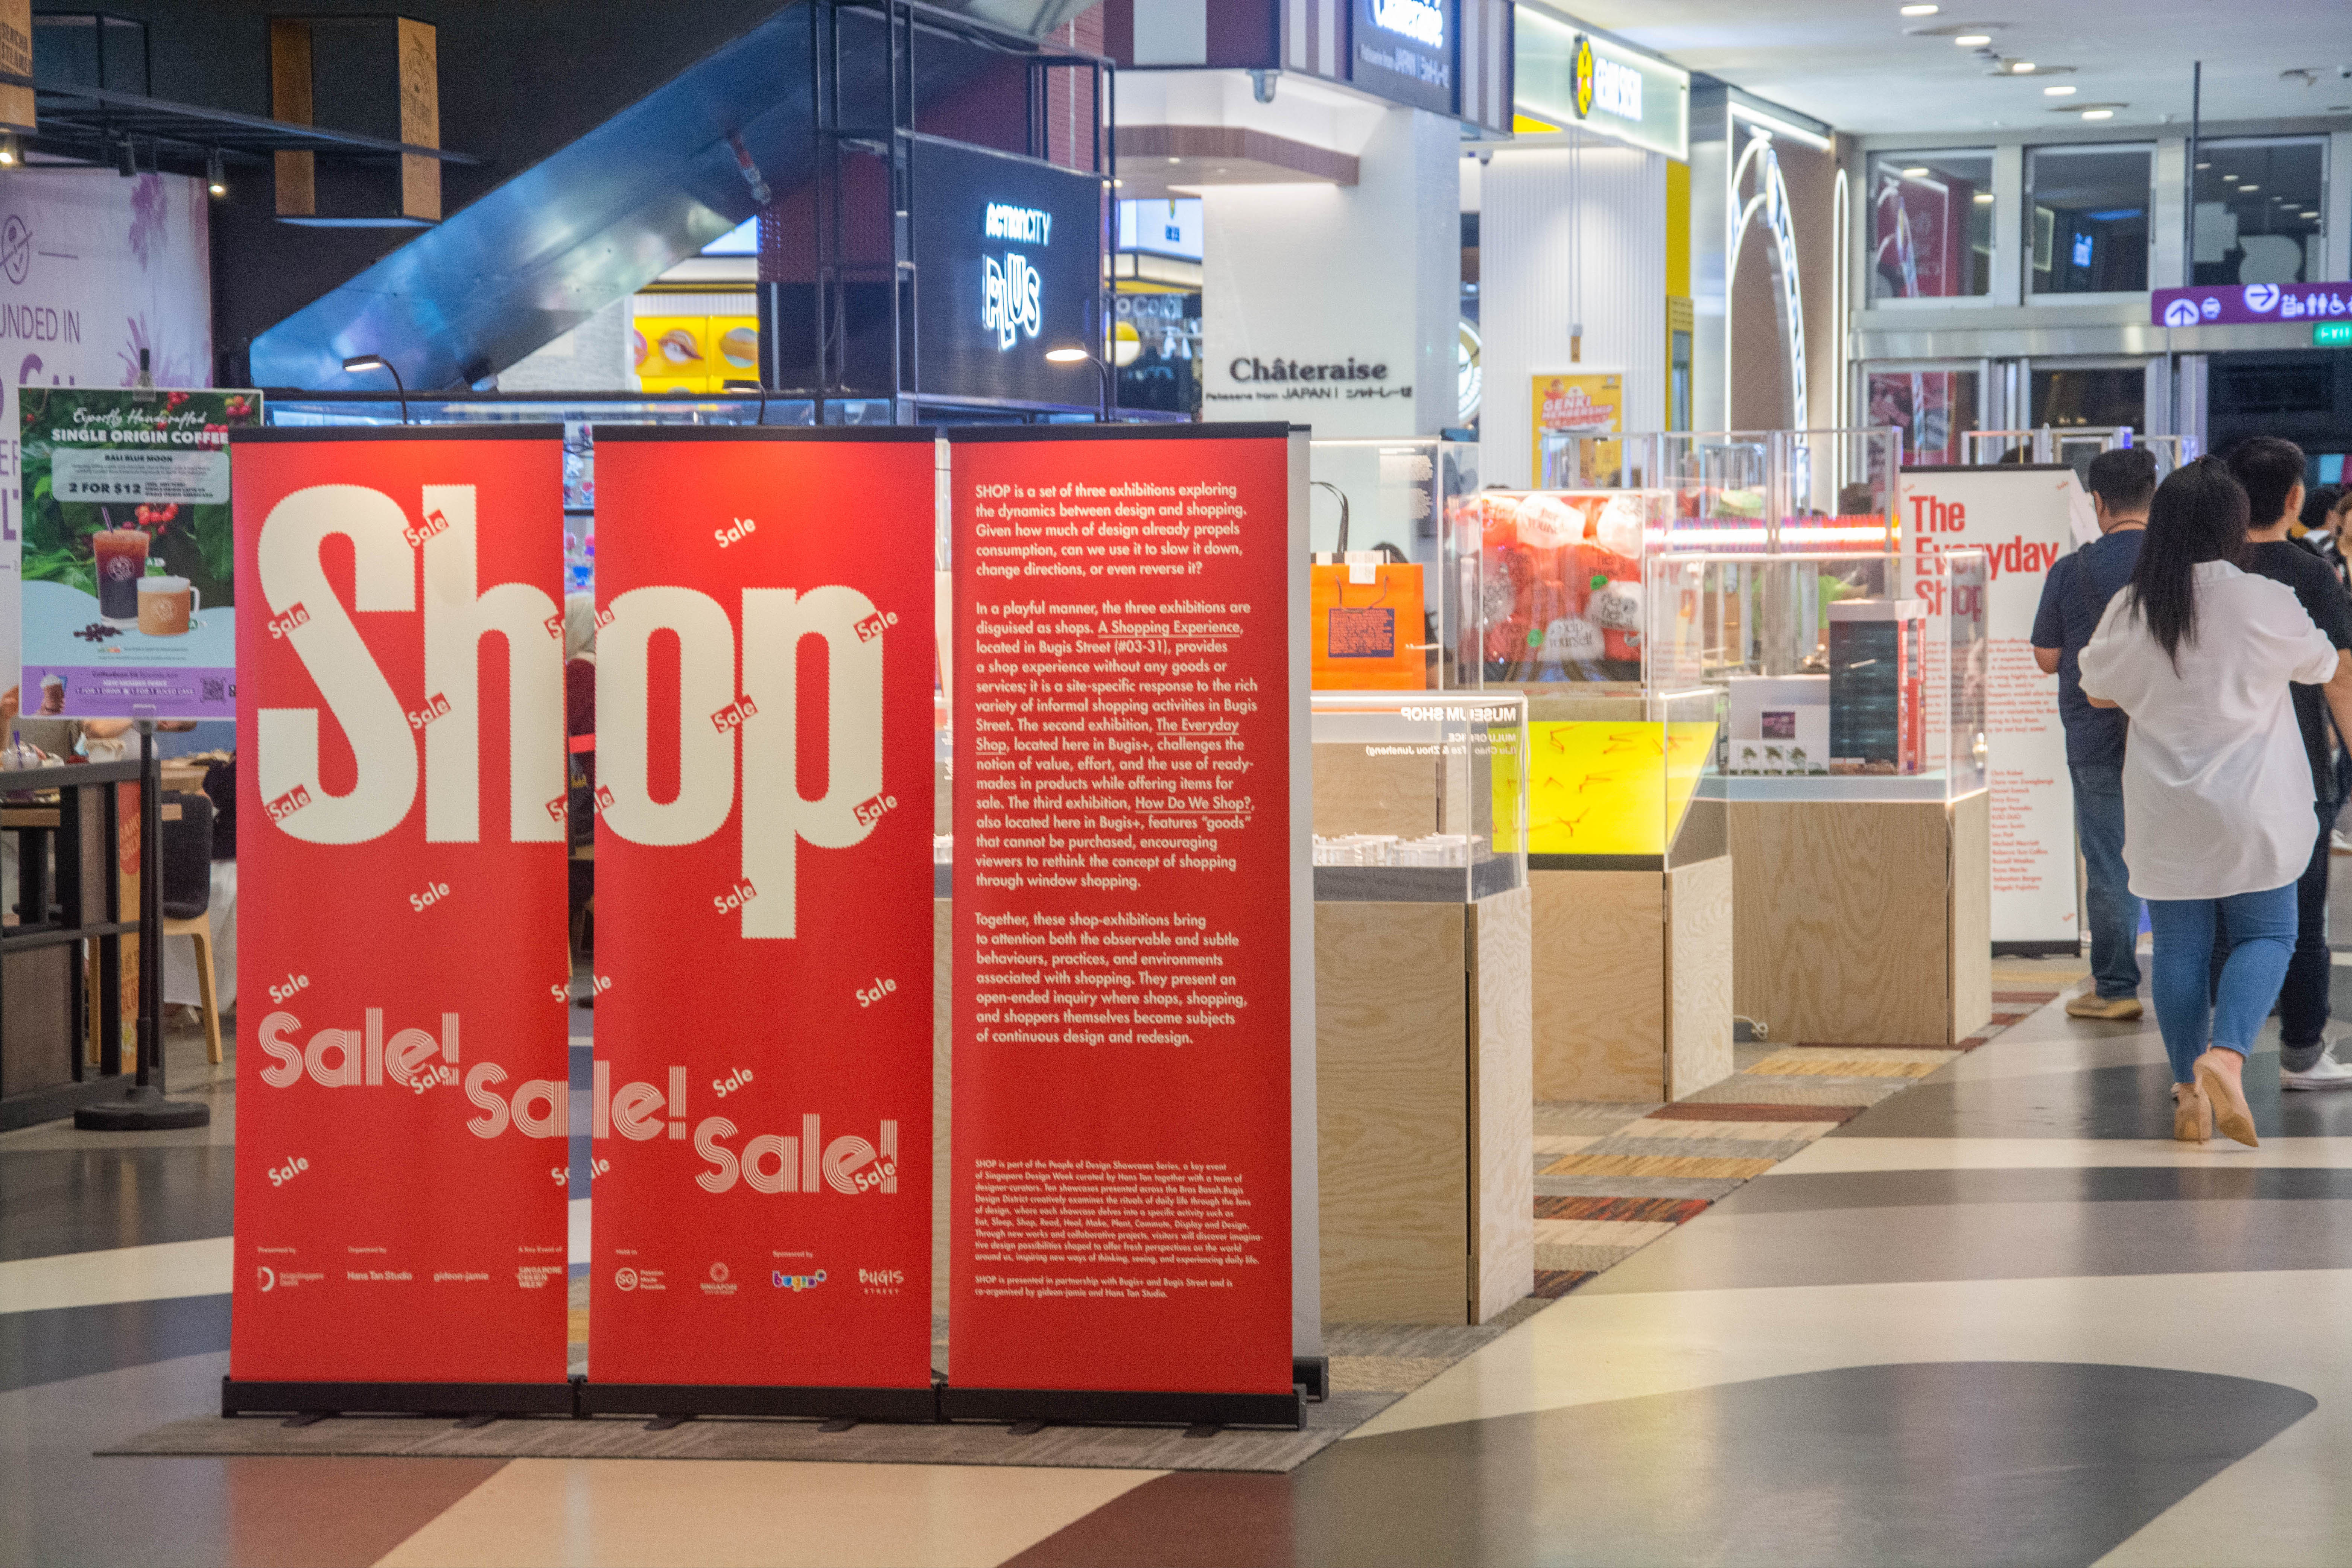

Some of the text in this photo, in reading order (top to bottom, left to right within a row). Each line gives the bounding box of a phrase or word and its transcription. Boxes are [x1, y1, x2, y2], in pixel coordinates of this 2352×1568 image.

[986, 252, 1040, 351] PLUS
[63, 309, 80, 344] IN
[1229, 357, 1387, 382] Châteraise
[1282, 388, 1331, 399] JAPAN
[52, 429, 229, 444] SINGLE ORIGIN COFFEE
[82, 483, 110, 493] FOR
[114, 483, 141, 495] $12
[975, 481, 1237, 500] SHOP is a set of three exhibitions exploring
[975, 501, 1248, 521] the dynamics between design and shopping.
[1909, 495, 1965, 532] The
[406, 514, 446, 548] Sale
[714, 517, 756, 548] Sale
[975, 521, 1241, 540] Given how much of design already propels
[975, 541, 1243, 560] consumption, can we use it to slow it down,
[975, 561, 1203, 579] change directions, or even reverse it?
[268, 607, 308, 639] Sale
[858, 611, 898, 642] Sale
[975, 639, 1228, 656] located in Bugis Street (#03-31), provides
[409, 699, 450, 730] Sale
[714, 700, 755, 733] Sale
[975, 717, 1240, 735] Street. The second exhibition, The Everyday
[268, 789, 309, 822] Sale
[855, 793, 898, 826] Sale
[409, 882, 450, 912] Sale
[714, 884, 755, 914] Sale
[974, 911, 1207, 929] Together, these shop-exhibitions bring
[269, 973, 309, 1004] Sale
[855, 977, 897, 1008] Sale
[258, 1008, 459, 1088] Sale!
[975, 1028, 1194, 1047] of continuous design and redesign.
[410, 1063, 451, 1095] Sale
[713, 1068, 754, 1098] Sale
[694, 1113, 898, 1195] Sale!
[268, 1157, 309, 1187] Sale
[855, 1160, 896, 1192] Sale
[347, 1270, 413, 1280] Hans Tan Studio
